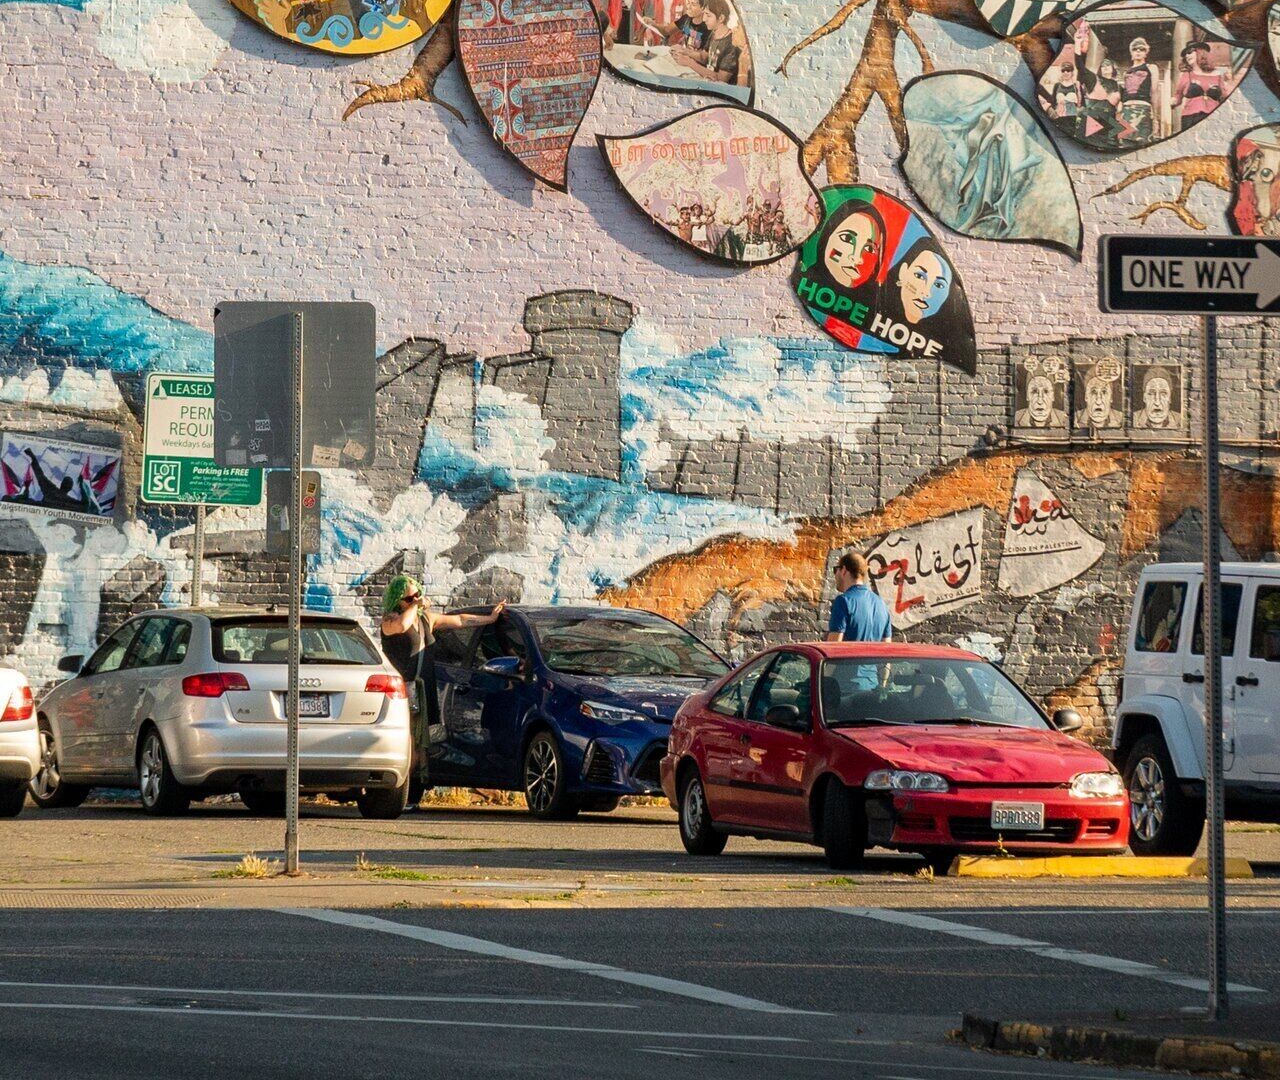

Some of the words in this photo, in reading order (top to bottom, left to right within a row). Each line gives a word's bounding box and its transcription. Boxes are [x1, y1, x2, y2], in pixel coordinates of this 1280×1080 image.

[1129, 259, 1184, 288] ONE
[1195, 260, 1251, 289] WAY
[797, 277, 870, 325] HOPE
[870, 312, 944, 357] HOPE
[169, 383, 212, 395] LEASED
[180, 406, 215, 420] PERM
[169, 422, 214, 437] REQUI
[162, 439, 200, 449] Weekdays
[153, 464, 177, 476] LOT
[192, 466, 222, 477] Parking
[223, 468, 229, 476] is
[230, 468, 249, 476] FREE
[153, 475, 176, 491] SC
[43, 508, 66, 518] Youth
[68, 513, 112, 524] Movement
[1039, 540, 1079, 551] PALESTINA
[936, 592, 954, 602] ALTO
